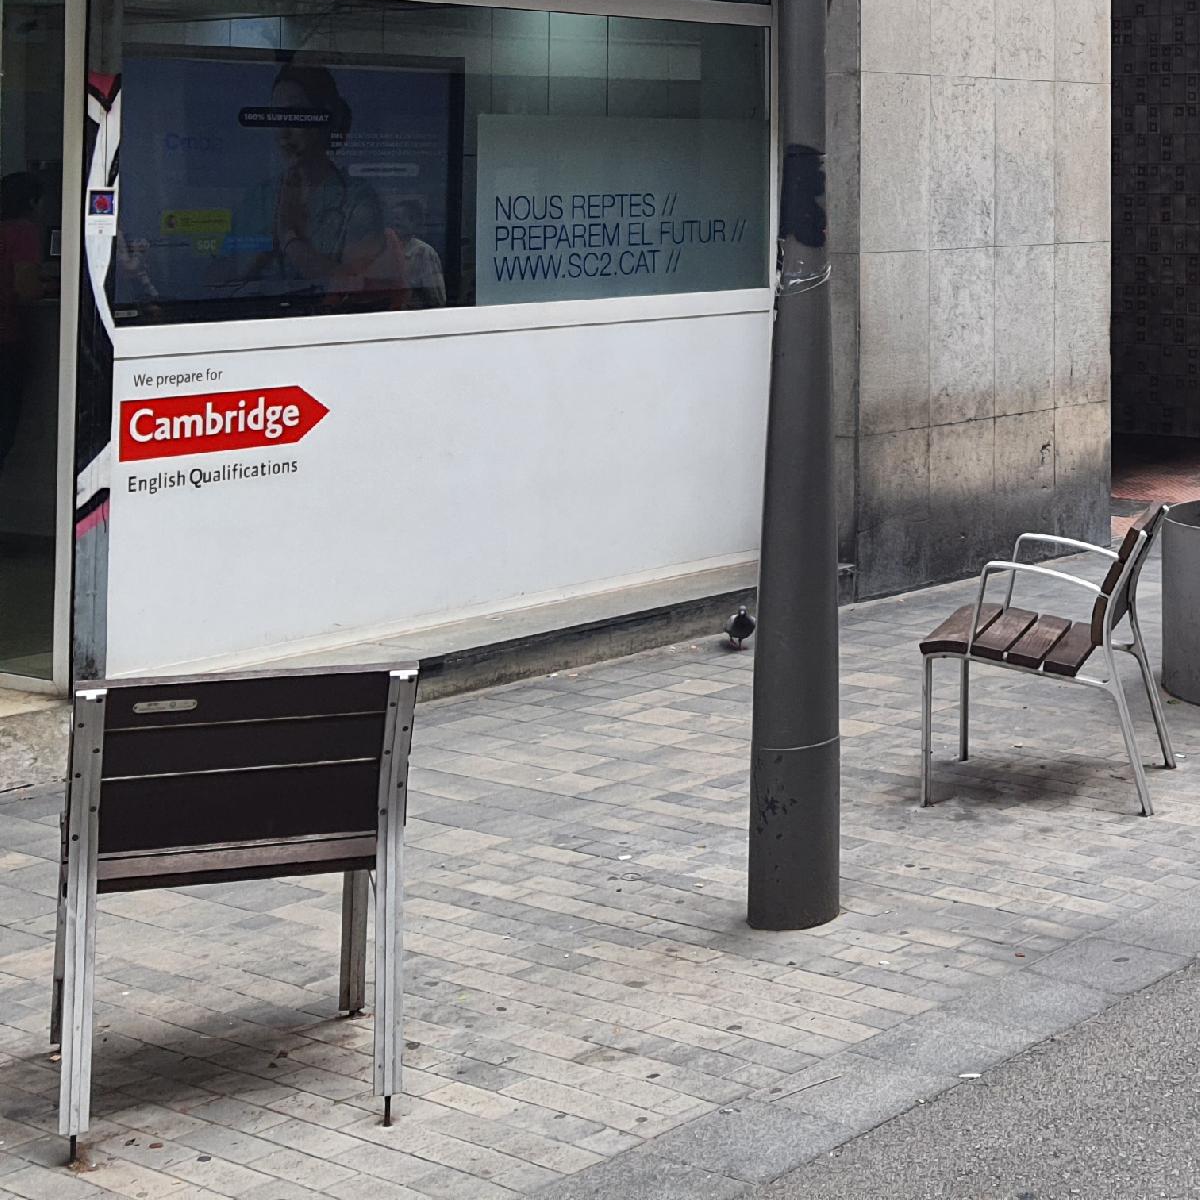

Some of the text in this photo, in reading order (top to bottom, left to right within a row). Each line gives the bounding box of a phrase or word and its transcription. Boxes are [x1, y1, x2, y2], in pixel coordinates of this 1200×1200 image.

[495, 195, 564, 221] NOUS
[572, 193, 656, 220] REPTES
[495, 223, 620, 251] PREPAREM
[628, 222, 653, 246] EL
[660, 220, 726, 245] FUTUR
[494, 250, 661, 282] WWW.SC2.CAT
[133, 368, 223, 388] We prepare for
[129, 397, 300, 443] Cambridge
[128, 460, 298, 494] English Qualifications
